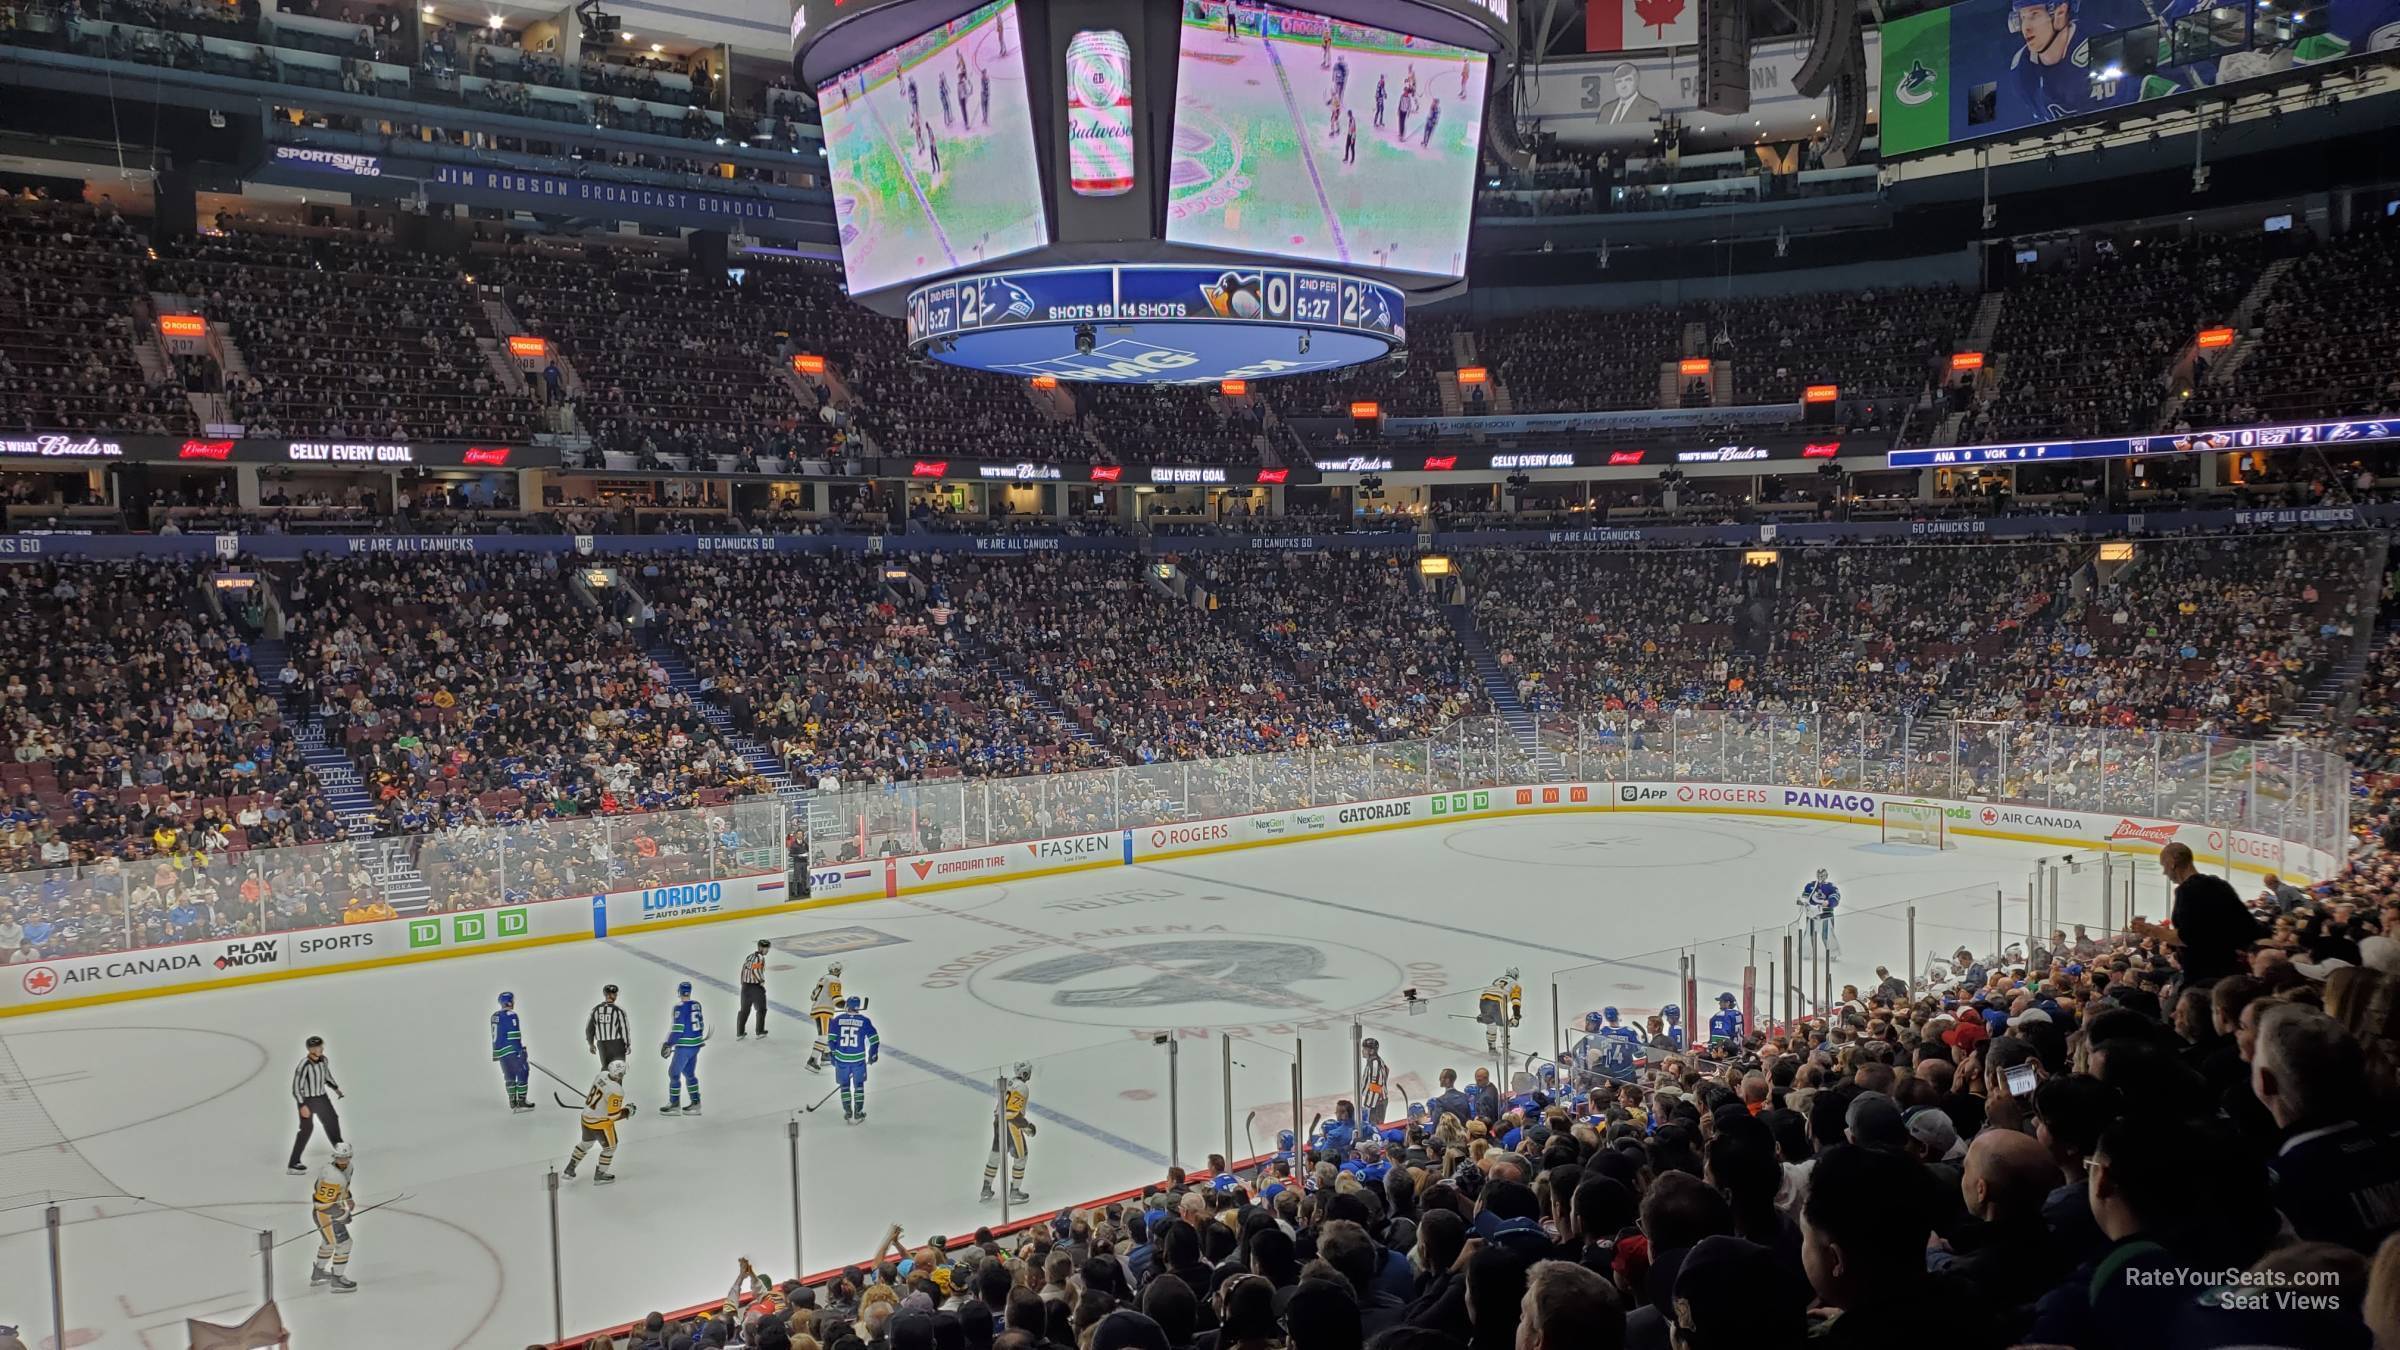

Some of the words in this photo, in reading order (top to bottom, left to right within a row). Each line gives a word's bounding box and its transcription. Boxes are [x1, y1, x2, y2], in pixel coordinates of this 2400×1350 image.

[1581, 76, 1600, 109] 3
[2089, 79, 2118, 101] 40
[276, 147, 377, 168] SPORTSNET
[355, 167, 380, 177] 650
[438, 168, 473, 186] JIM
[488, 174, 567, 196] ROBSON
[581, 184, 686, 209] BROADCAST
[699, 198, 775, 219] GONDOLA
[1299, 279, 1318, 291] 2ND
[1319, 280, 1337, 293] PER
[941, 288, 955, 300] PER
[1267, 278, 1287, 314] 0
[961, 286, 977, 322] 2
[1121, 304, 1136, 317] 14
[1138, 303, 1186, 317] SHOTS
[1297, 299, 1330, 320] 5:27
[1343, 286, 1359, 321] 2
[917, 298, 926, 331] 0
[929, 306, 950, 330] 5:27
[1049, 304, 1093, 319] SHOTS
[1096, 304, 1112, 317] 19
[2241, 431, 2254, 445] 0
[2260, 434, 2286, 445] 5:27
[2300, 427, 2314, 442] 2
[7, 441, 38, 452] WHAT
[38, 435, 101, 455] Buds
[103, 444, 122, 455] DO.
[290, 443, 329, 459] CELLY
[332, 444, 374, 460] EVERY
[377, 446, 412, 462] GOAL
[2134, 445, 2144, 453] 14
[1491, 455, 1517, 467] CELLY
[1519, 454, 1547, 467] EVERY
[1549, 453, 1574, 465] GOAL
[1678, 452, 1700, 461] THAT'S
[1701, 452, 1718, 460] WHAT
[1718, 447, 1756, 462] Buds
[1934, 452, 1956, 462] ANA
[1964, 451, 1971, 460] 0
[1984, 449, 2007, 459] VGK
[2019, 448, 2026, 457] 4
[2038, 447, 2045, 457] F
[980, 467, 1001, 476] THAT'S
[1001, 467, 1016, 477] WHAT
[1017, 464, 1050, 479] Buds
[1332, 461, 1348, 470] WHAT
[1348, 457, 1381, 471] Buds
[1151, 468, 1173, 482] CELLY
[1174, 468, 1200, 482] EVERY
[1202, 469, 1225, 482] GOAL
[2235, 512, 2250, 524] WE
[2254, 512, 2274, 523] ARE
[2278, 511, 2297, 522] ALL
[2300, 509, 2353, 521] CANUCKS
[1912, 523, 1925, 534] GO
[1927, 522, 1970, 534] CANUCKS
[1972, 521, 1985, 532] GO
[576, 538, 593, 549] 106
[698, 538, 711, 550] GO
[714, 538, 759, 550] CANUCKS
[762, 538, 775, 550] GO
[868, 537, 883, 549] 107
[976, 538, 988, 550] WE
[990, 538, 1006, 550] ARE
[1008, 538, 1021, 550] ALL
[1023, 538, 1059, 550] CANUCKS
[1251, 538, 1262, 548] GO
[1264, 538, 1299, 548] CANUCKS
[1301, 537, 1312, 548] GO
[1549, 532, 1562, 543] WE
[1564, 531, 1580, 542] ARE
[1583, 531, 1597, 542] ALL
[1600, 530, 1640, 541] CANUCKS
[20, 538, 40, 553] GO
[216, 538, 237, 551] 105
[348, 538, 367, 551] WE
[370, 538, 393, 551] ARE
[397, 538, 416, 551] ALL
[420, 538, 474, 551] CANUCKS
[1699, 788, 1767, 803] ROGERS
[1784, 790, 1874, 813] PANAGO
[1296, 814, 1325, 826] NexGen
[1338, 801, 1411, 824] GATORADE
[1255, 818, 1285, 830] NexGen
[1308, 822, 1325, 830] Energy
[2001, 812, 2022, 824] AIR
[2025, 815, 2082, 830] CANADA
[1170, 824, 1228, 845] ROGERS
[1267, 826, 1284, 834] Energy
[1041, 835, 1109, 858] FASKEN
[2228, 835, 2283, 861] ROGER
[937, 859, 985, 874] CANADIAN
[986, 856, 1005, 868] TIRE
[642, 882, 721, 911] LORDCO
[655, 909, 679, 919] AUTO
[680, 906, 708, 918] PARTS
[1072, 924, 1228, 940] ARENA
[227, 940, 277, 957] PLAY
[299, 933, 374, 954] SPORTS
[226, 950, 278, 968] NOW
[63, 965, 102, 984] AIR
[106, 954, 201, 978] CANADA
[599, 1014, 610, 1023] 90
[1714, 1021, 1723, 1029] 35
[840, 1026, 859, 1047] 55
[585, 1084, 604, 1110] 87
[319, 1186, 336, 1199] 58
